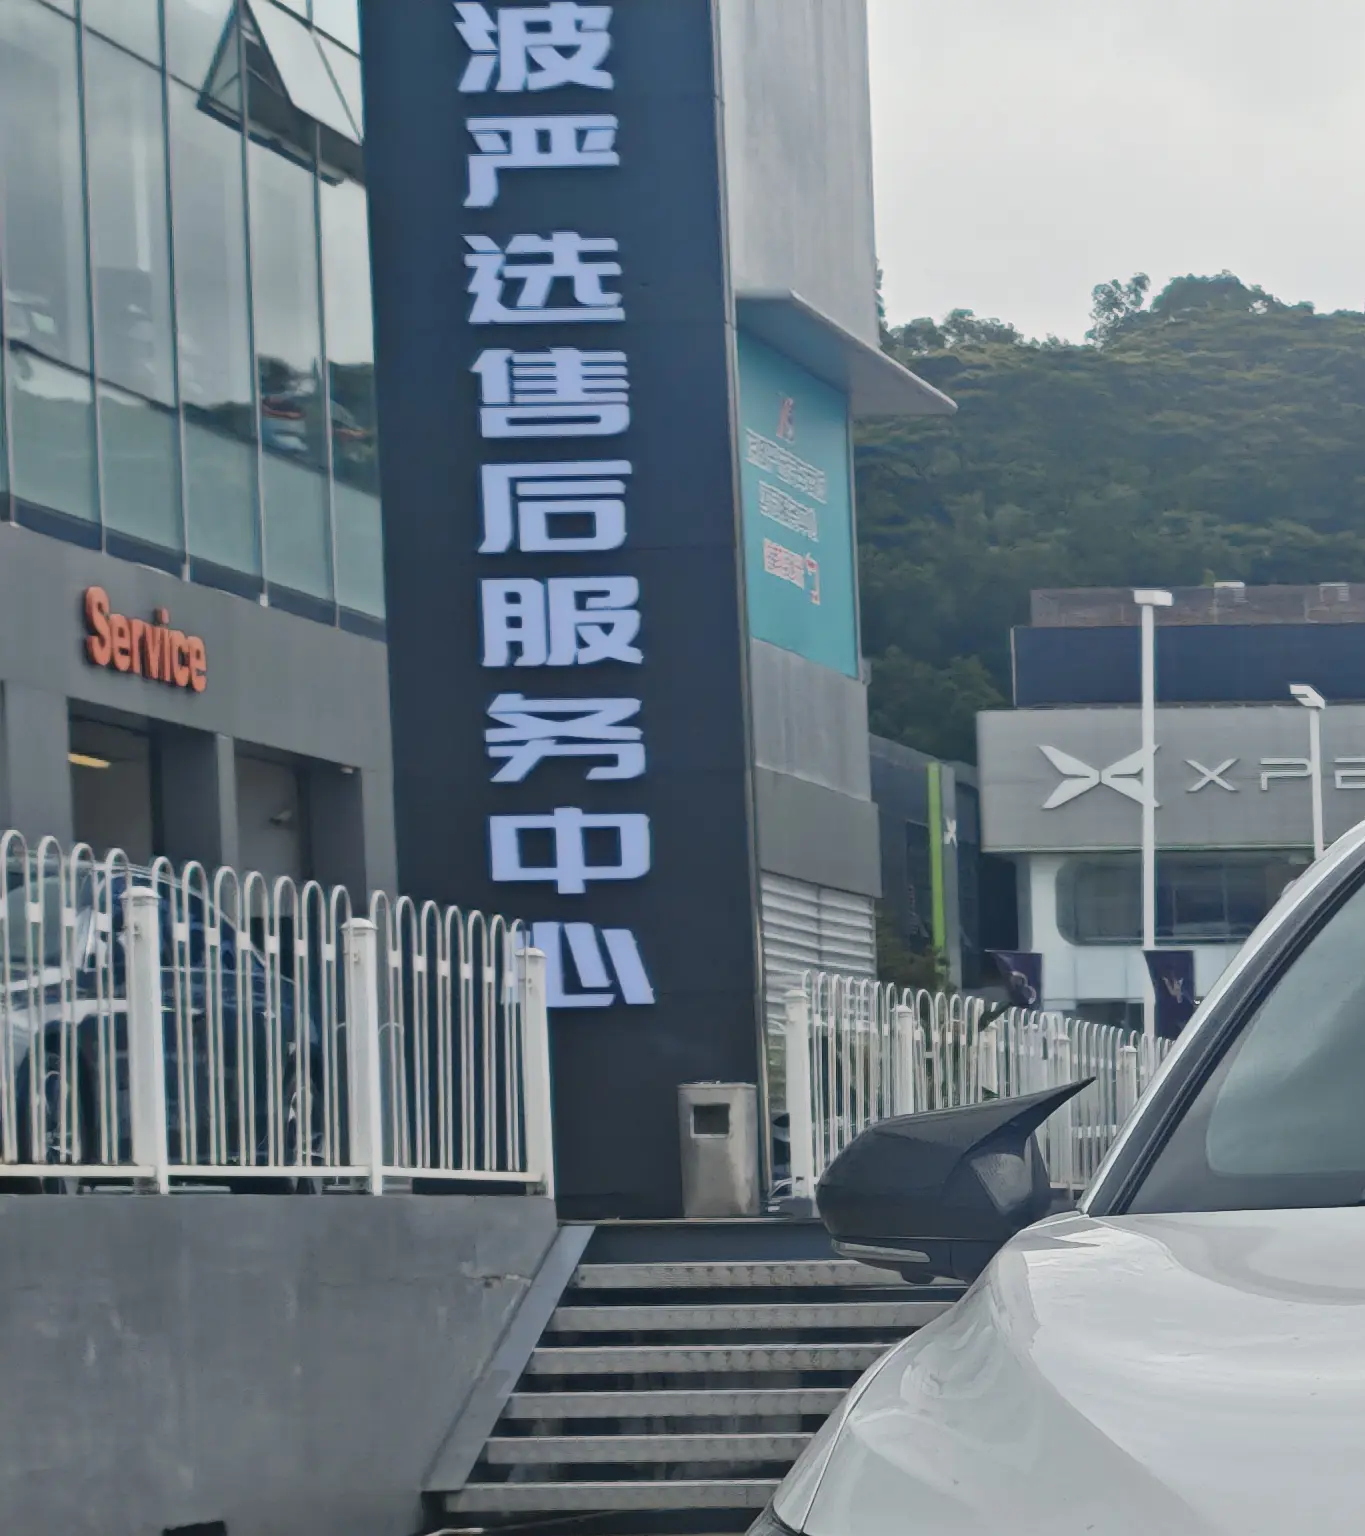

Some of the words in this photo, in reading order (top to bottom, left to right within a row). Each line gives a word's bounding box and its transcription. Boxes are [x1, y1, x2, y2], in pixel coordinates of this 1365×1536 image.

[86, 585, 207, 693] Service
[454, 1, 656, 1007] 波严选售后服务中心
